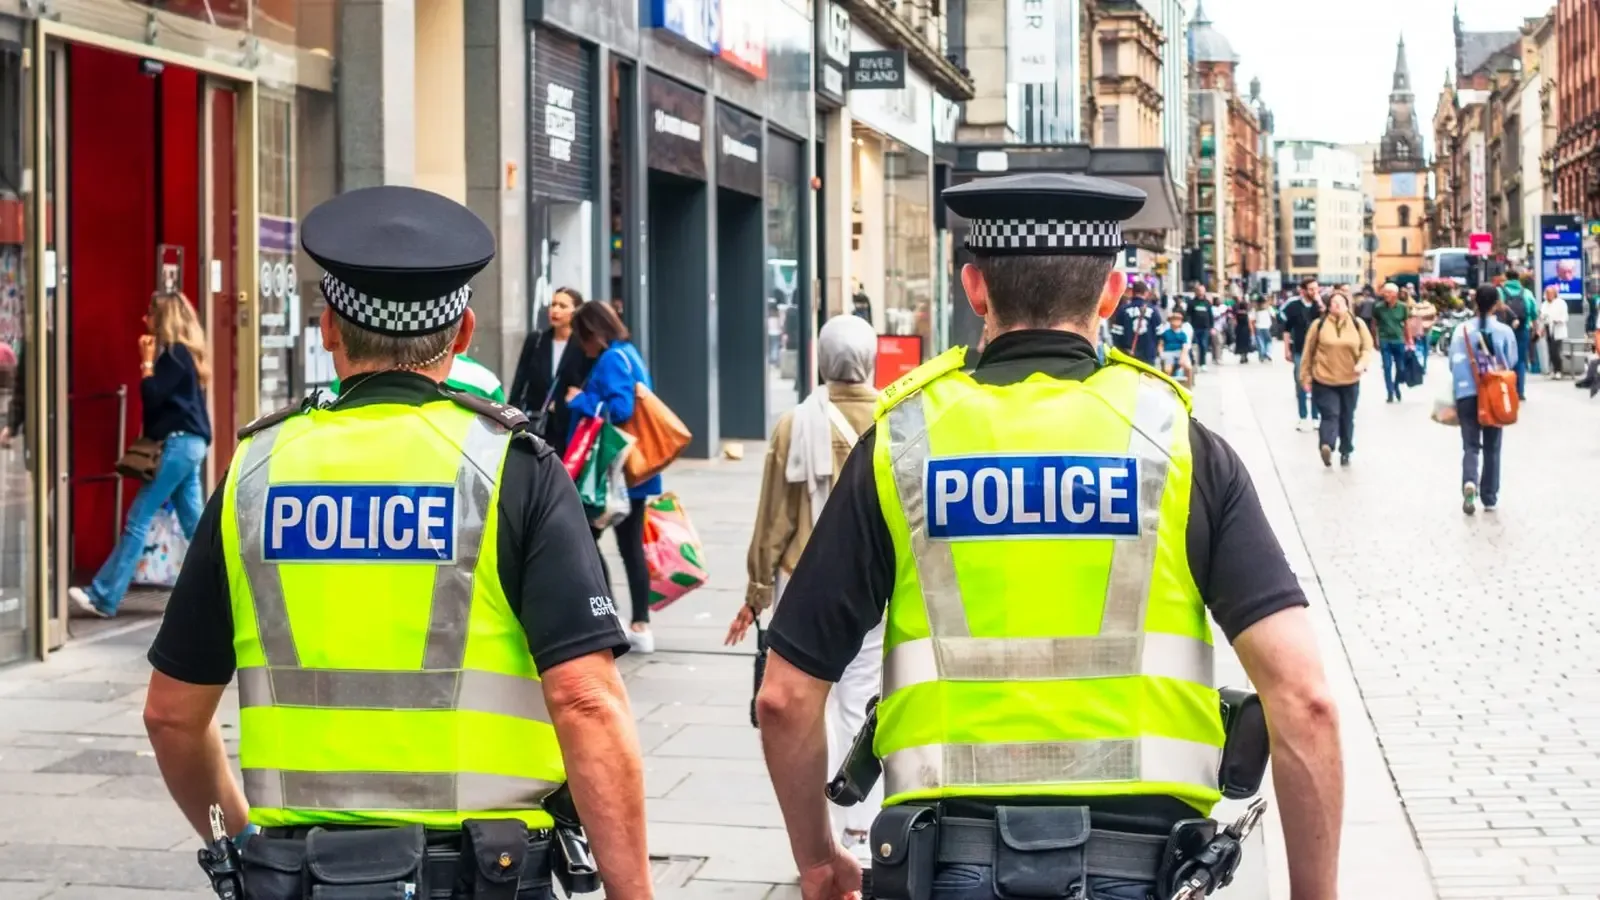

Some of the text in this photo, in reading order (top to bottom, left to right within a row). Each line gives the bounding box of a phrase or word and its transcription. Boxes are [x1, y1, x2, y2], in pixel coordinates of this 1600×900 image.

[855, 70, 899, 82] ISLAND
[859, 56, 894, 69] RIVER
[935, 466, 1130, 526] POLICE
[272, 495, 446, 550] POLICE
